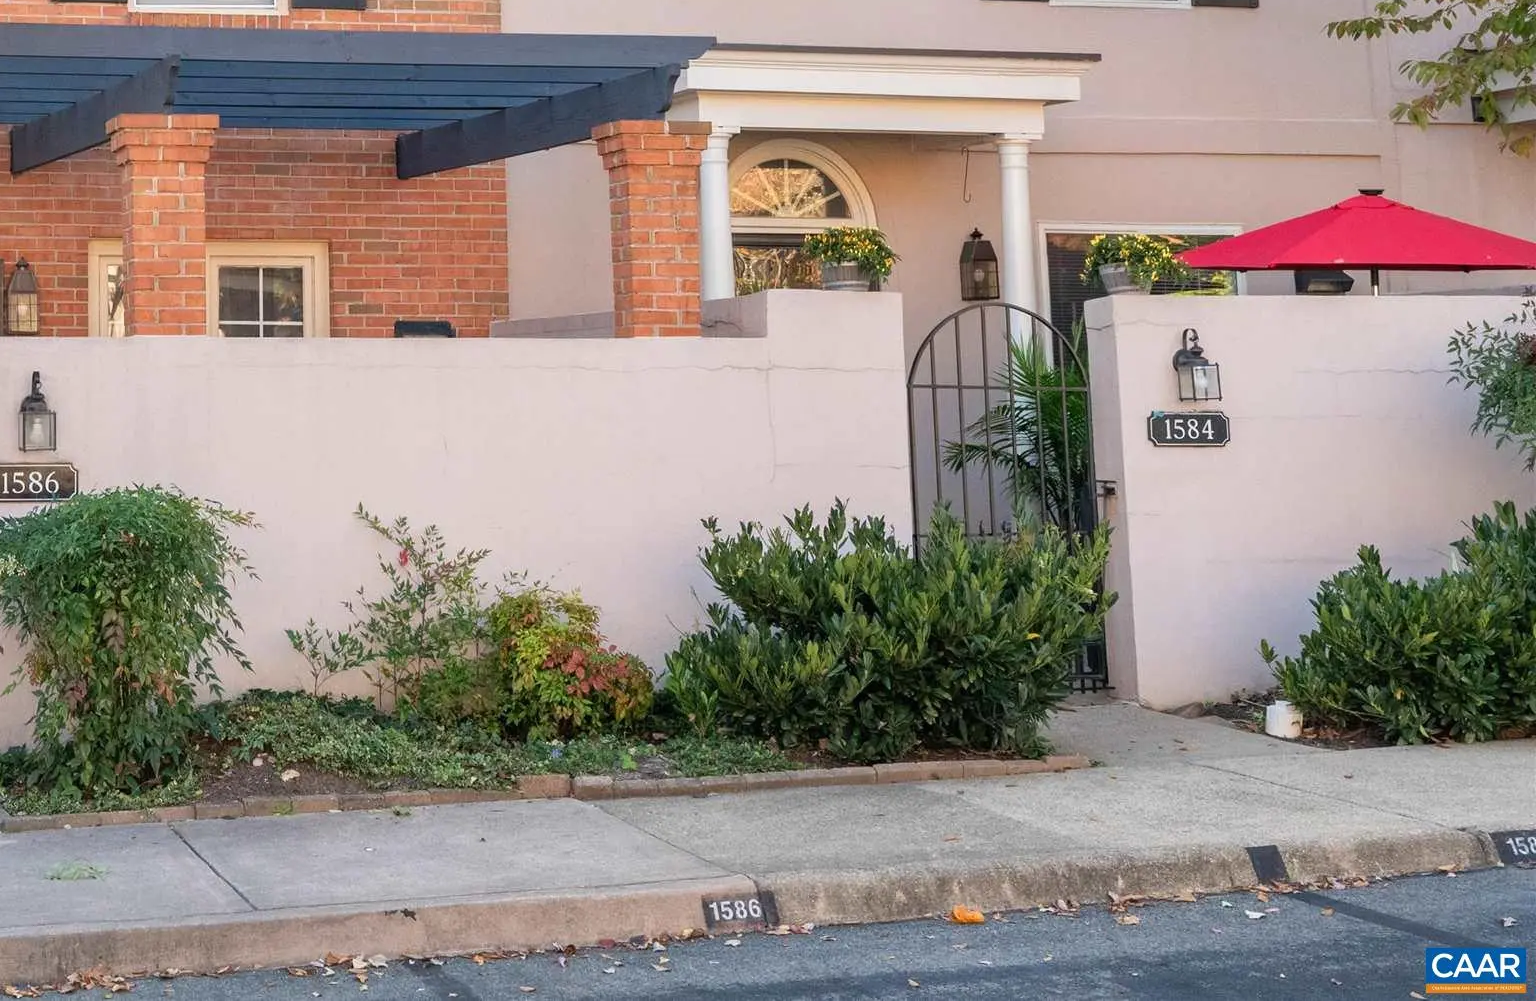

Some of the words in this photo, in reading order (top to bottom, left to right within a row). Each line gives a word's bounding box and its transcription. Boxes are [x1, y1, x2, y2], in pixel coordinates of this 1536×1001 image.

[1164, 418, 1215, 440] 1584
[2, 471, 60, 494] 1586
[709, 898, 762, 921] 1586
